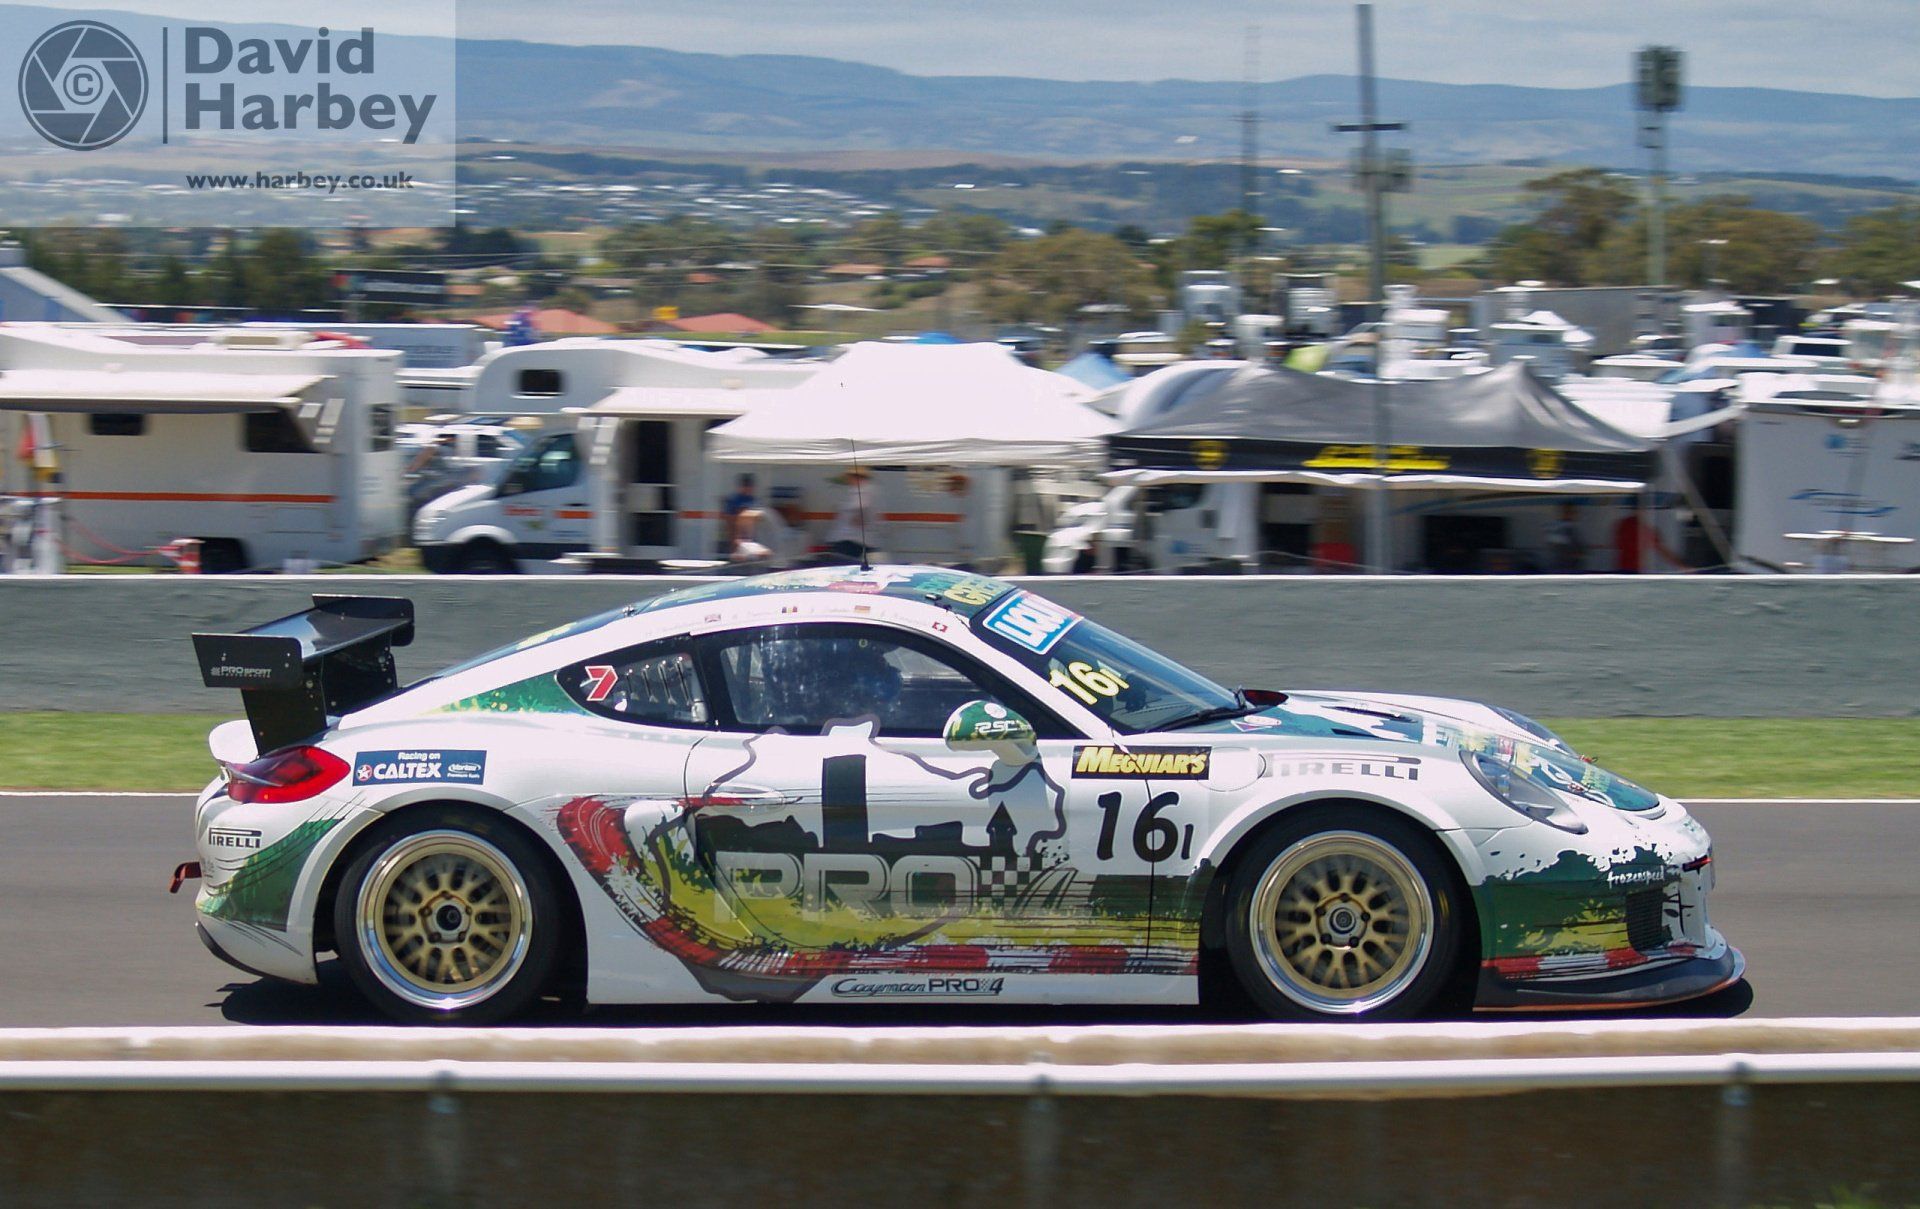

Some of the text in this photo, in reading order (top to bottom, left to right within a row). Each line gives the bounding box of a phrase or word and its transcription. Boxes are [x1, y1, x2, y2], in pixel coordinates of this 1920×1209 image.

[398, 752, 427, 761] Racing
[1258, 753, 1421, 780] PIRELLI
[373, 763, 441, 779] CALTEX
[209, 827, 262, 848] PIRELLI
[713, 851, 979, 923] PRO
[831, 978, 925, 997] Cayman
[929, 978, 979, 992] PRO
